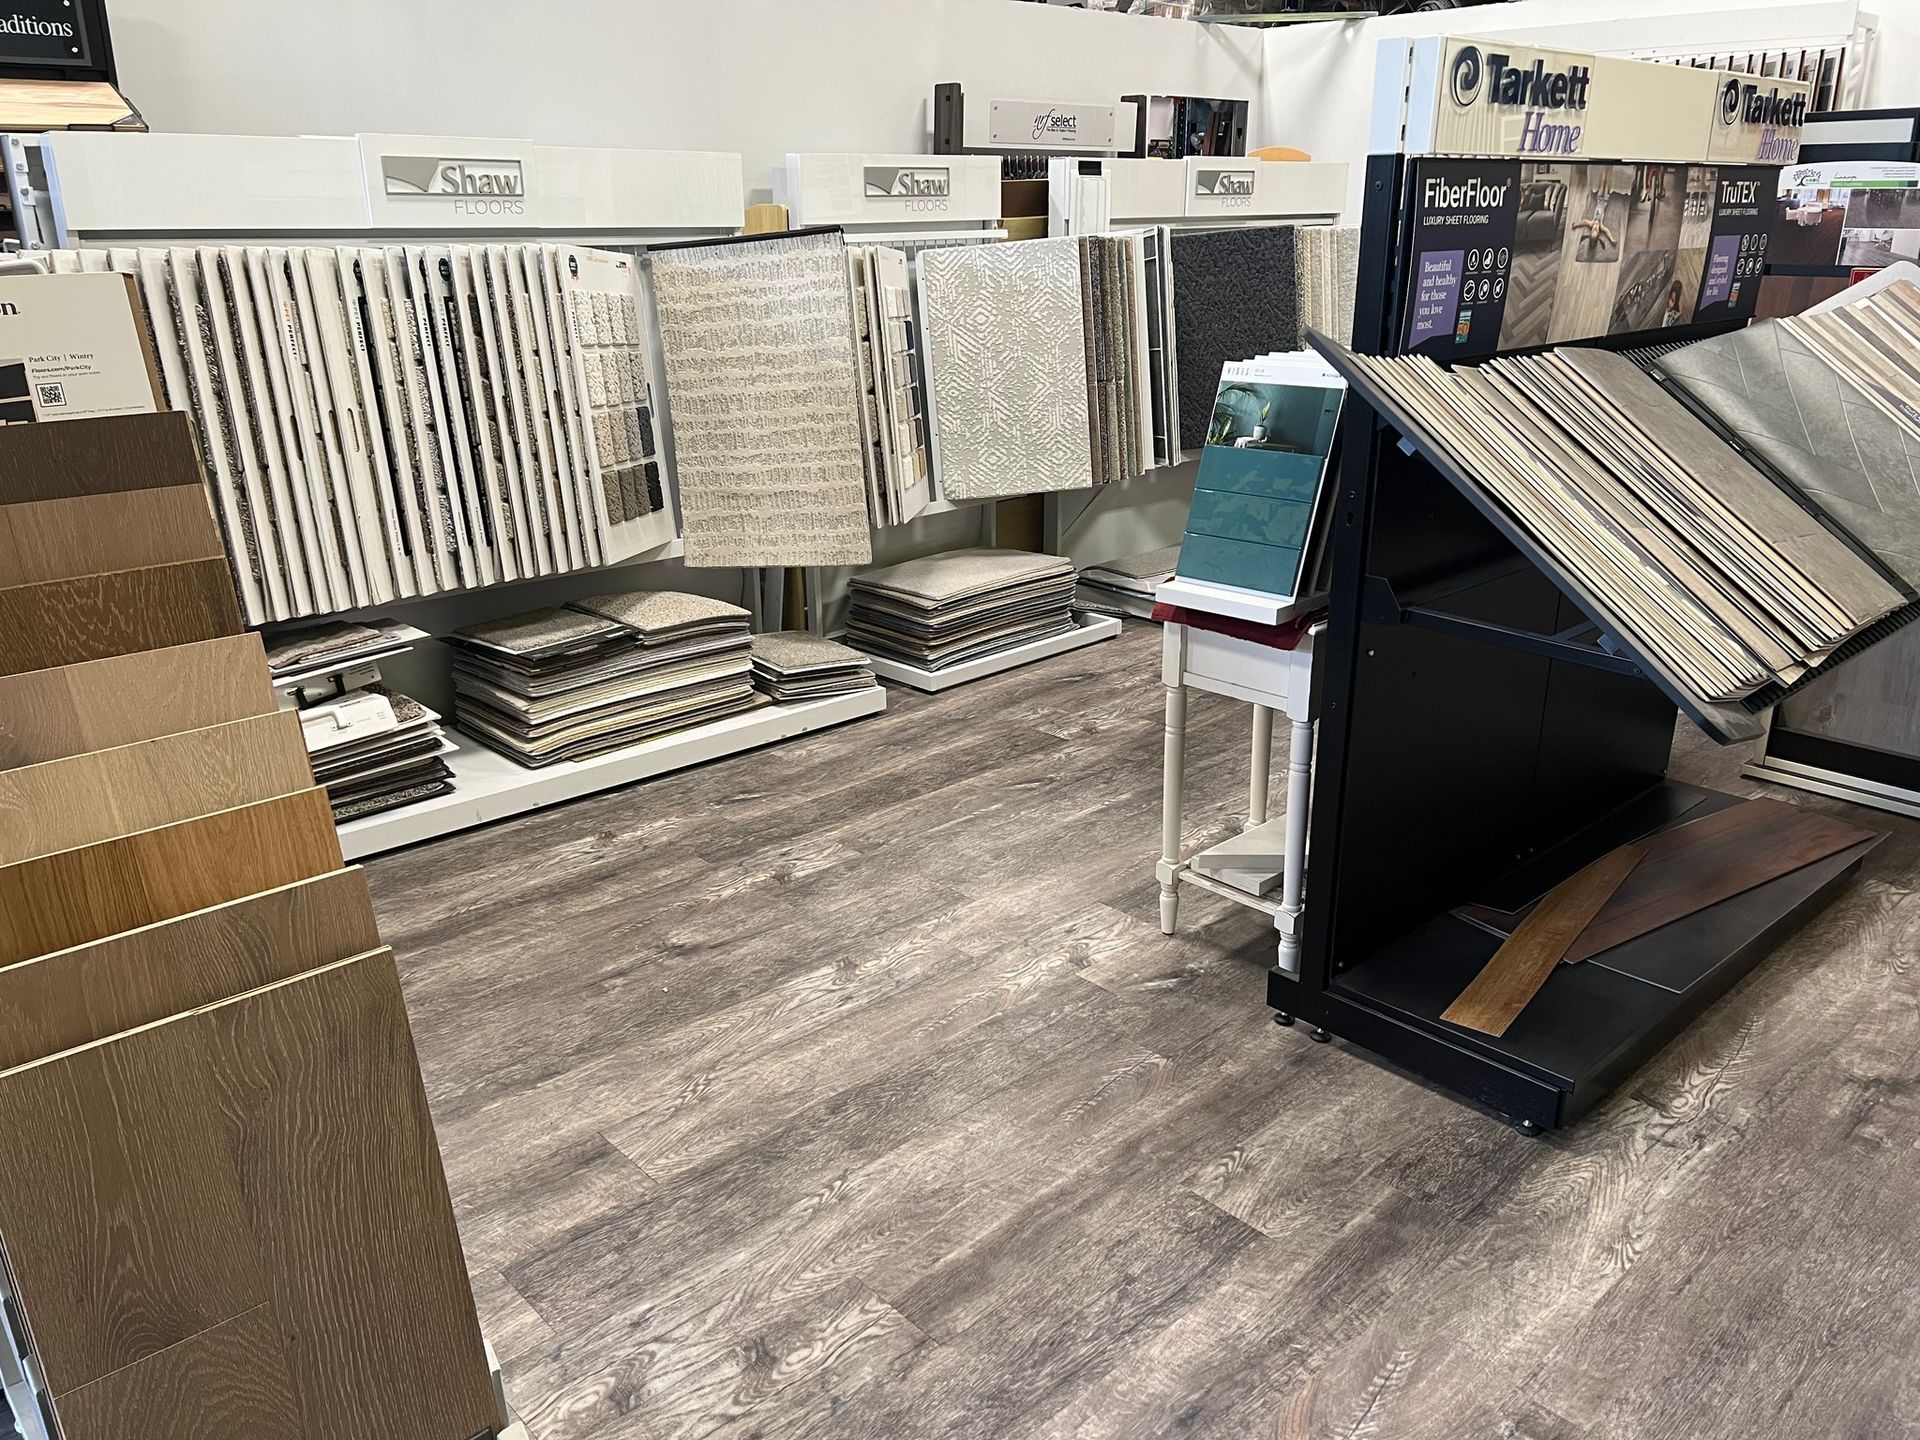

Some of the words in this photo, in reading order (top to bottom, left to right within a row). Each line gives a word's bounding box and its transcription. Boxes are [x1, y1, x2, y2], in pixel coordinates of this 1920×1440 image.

[1487, 53, 1590, 110] Tarkett
[1742, 84, 1806, 127] Tarkett
[1050, 114, 1076, 128] select
[1517, 111, 1582, 155] Home
[1758, 128, 1799, 160] Home
[441, 164, 519, 194] Shaw
[898, 172, 947, 195] Shaw
[1219, 174, 1254, 194] Shaw
[454, 200, 524, 215] FLOORS
[905, 200, 948, 212] FLOORS
[1221, 197, 1251, 208] FLOORS
[1423, 215, 1445, 226] LUXURY
[1445, 214, 1463, 225] SHEET
[1463, 214, 1489, 225] FLOORING
[1425, 260, 1452, 272] Beautiful
[1423, 276, 1434, 287] and
[1435, 274, 1457, 287] healthy
[1421, 290, 1430, 301] for
[1431, 289, 1447, 301] those
[1418, 306, 1430, 318] you
[1431, 304, 1443, 314] love
[69, 353, 94, 361] Wintry
